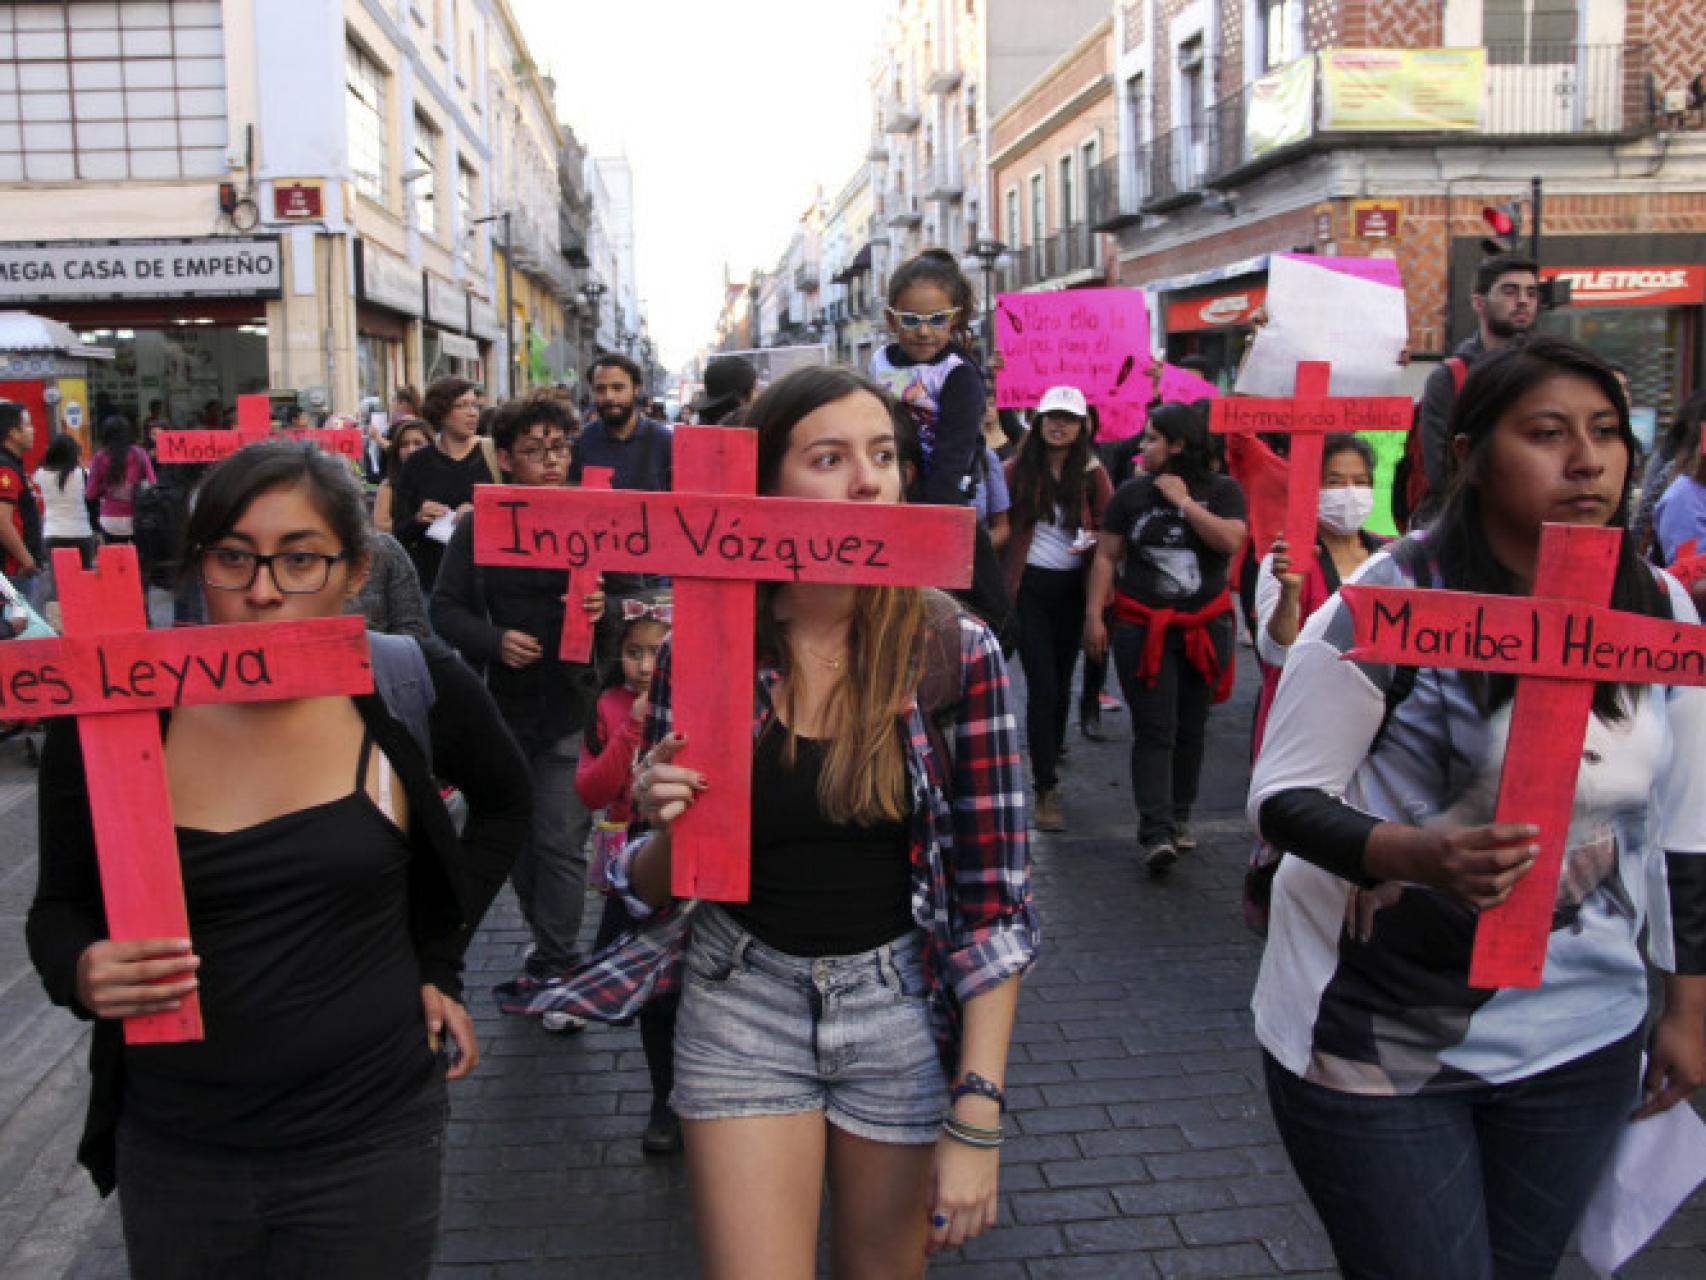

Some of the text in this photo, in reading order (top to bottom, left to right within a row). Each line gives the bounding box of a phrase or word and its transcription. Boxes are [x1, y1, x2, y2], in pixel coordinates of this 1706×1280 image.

[63, 258, 127, 280] CASA
[135, 257, 165, 279] DE
[173, 251, 273, 277] EMPEÑO
[496, 501, 889, 582] Ingrid Vázquez
[1370, 599, 1704, 677] Maribel Hernán
[97, 646, 272, 707] Leyva
